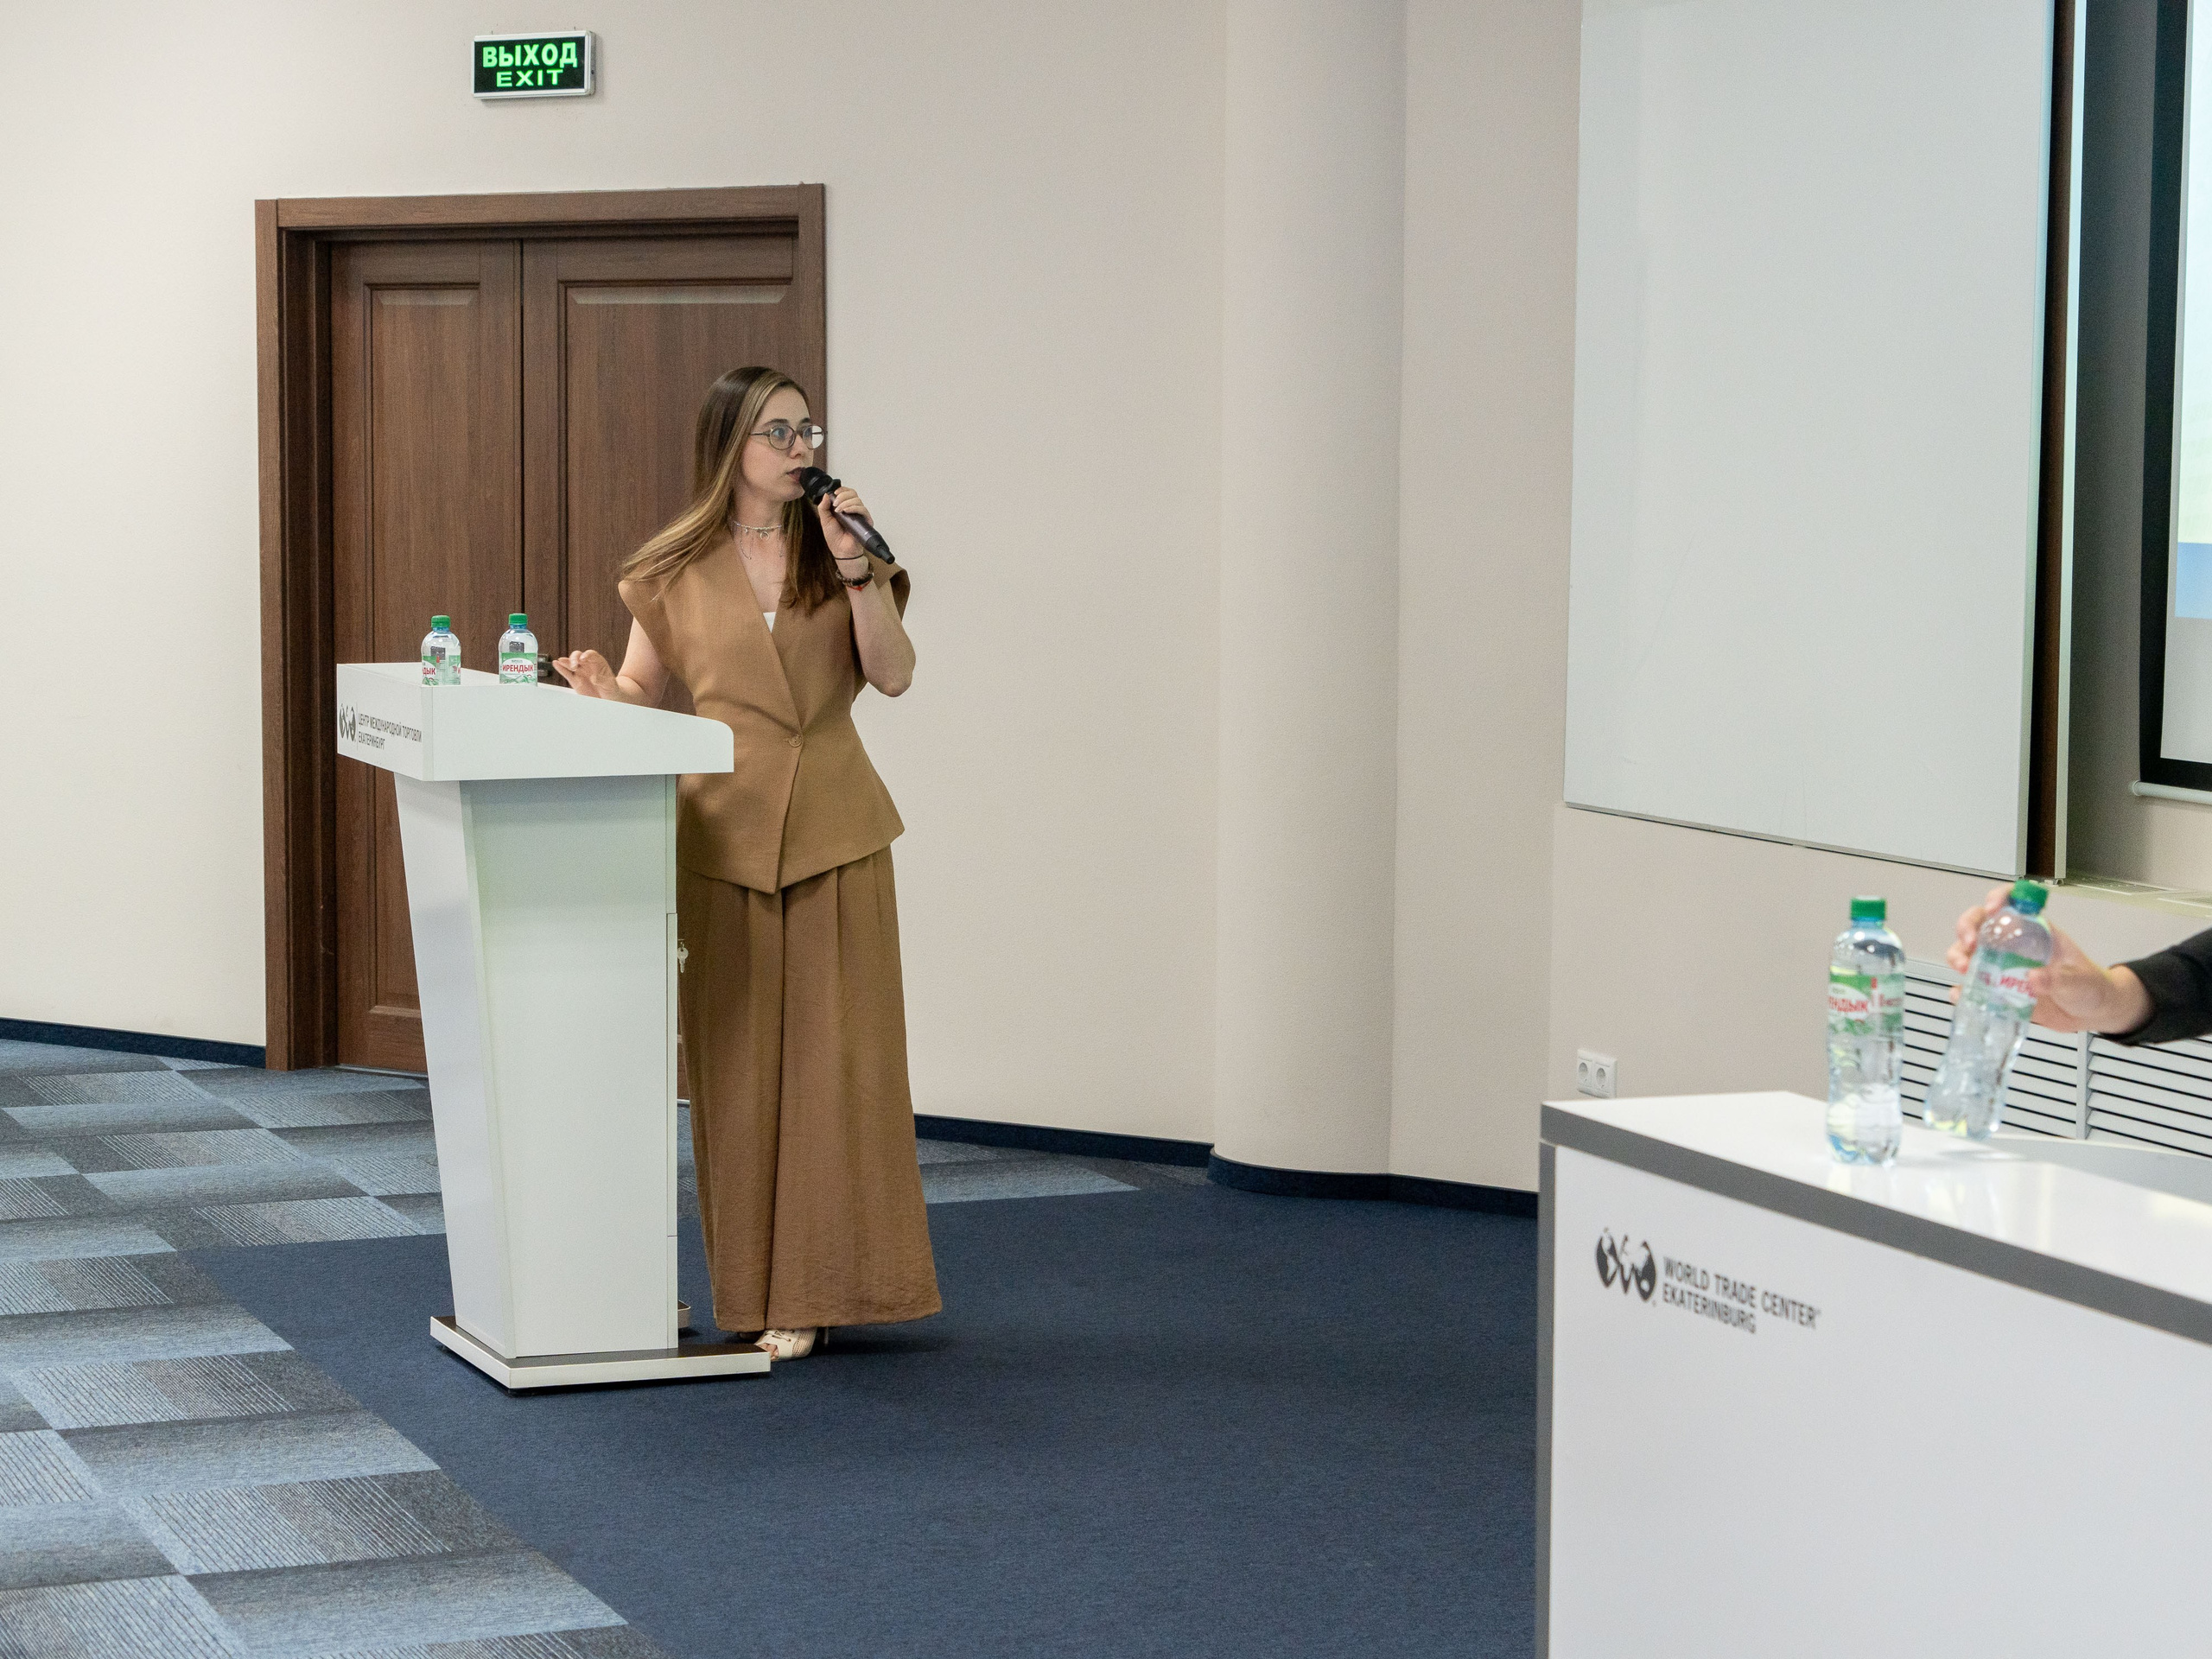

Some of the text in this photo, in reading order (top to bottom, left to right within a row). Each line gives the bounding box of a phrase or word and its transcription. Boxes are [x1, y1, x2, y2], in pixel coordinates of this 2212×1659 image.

[482, 42, 578, 68] ВЫХОД
[496, 69, 563, 87] EXIT
[502, 664, 534, 674] ИРЕНДЫК
[358, 731, 385, 750] ЕКАТЕРИНБУРГ
[1663, 1256, 1710, 1292] WORLD
[1714, 1274, 1757, 1308] TRADE
[1662, 1282, 1757, 1334] EKATERINBURG
